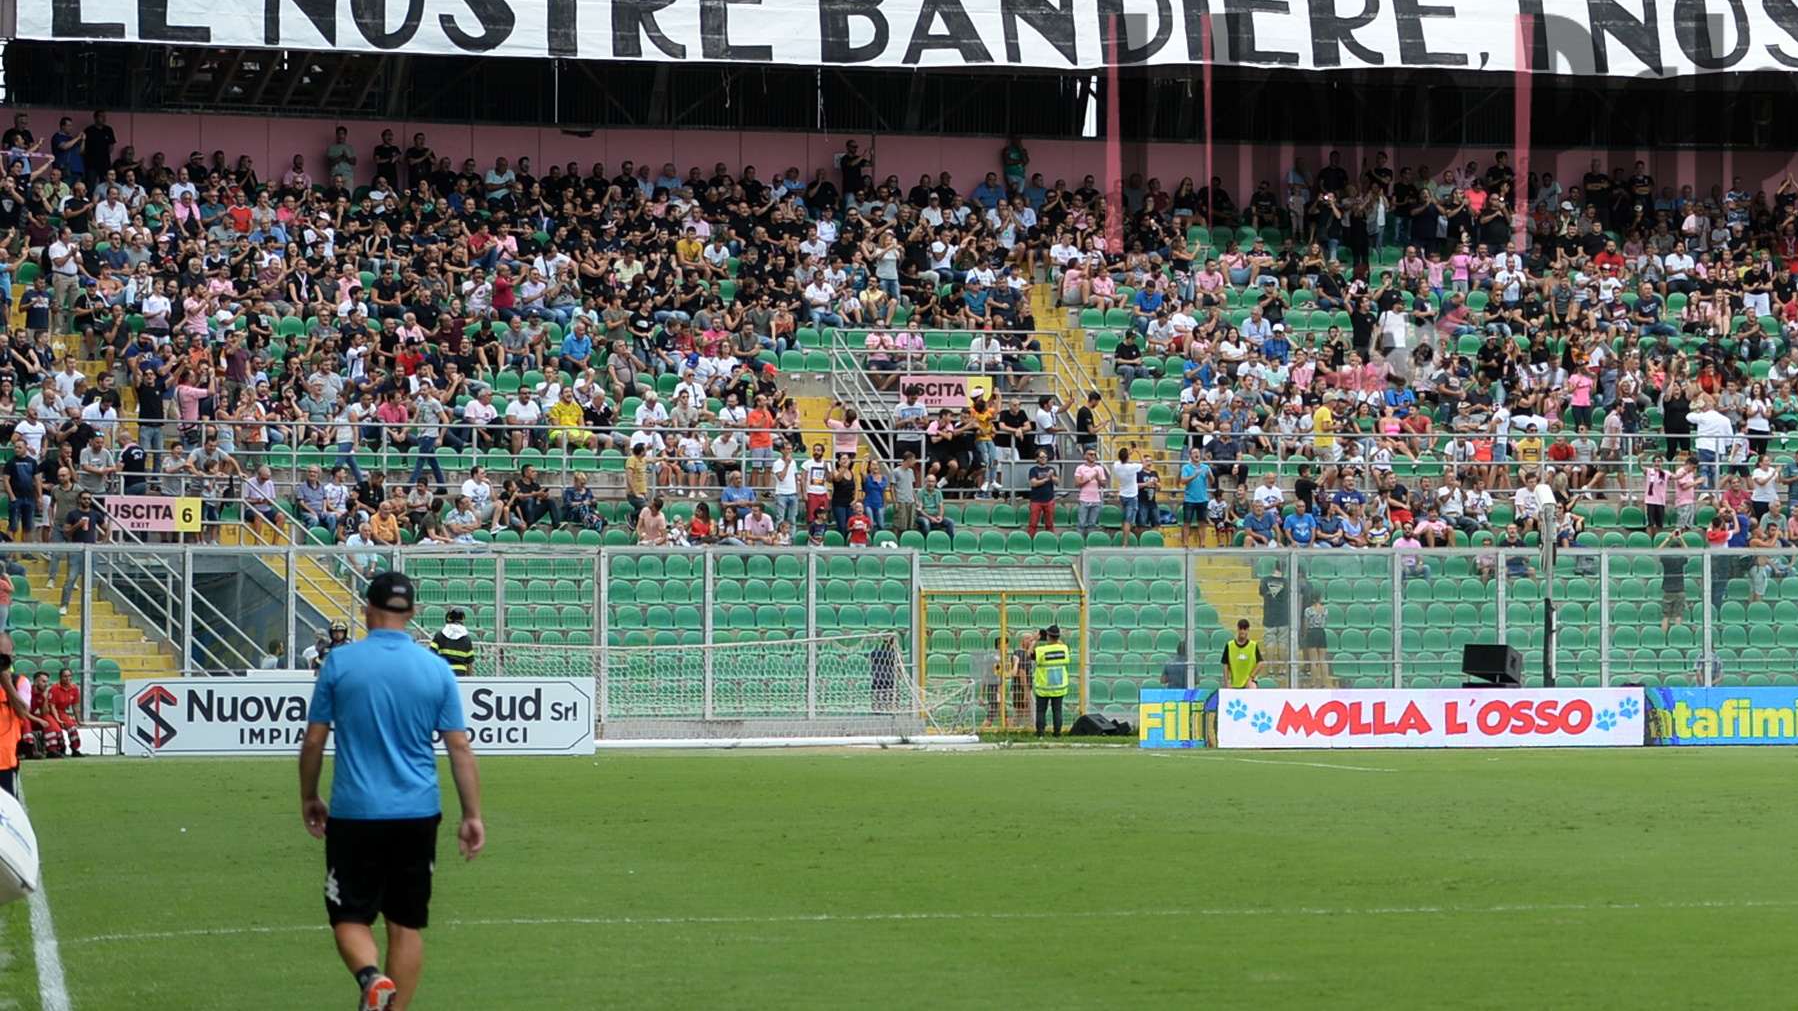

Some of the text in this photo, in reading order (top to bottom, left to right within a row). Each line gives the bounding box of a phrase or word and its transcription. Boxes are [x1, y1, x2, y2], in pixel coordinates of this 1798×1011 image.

[107, 504, 193, 524] USCITA 6
[130, 521, 151, 529] EXIT
[186, 689, 308, 723] Nuova
[470, 687, 542, 722] Sud
[1275, 699, 1433, 739] MOLLA
[1444, 696, 1593, 737] L'OSSO
